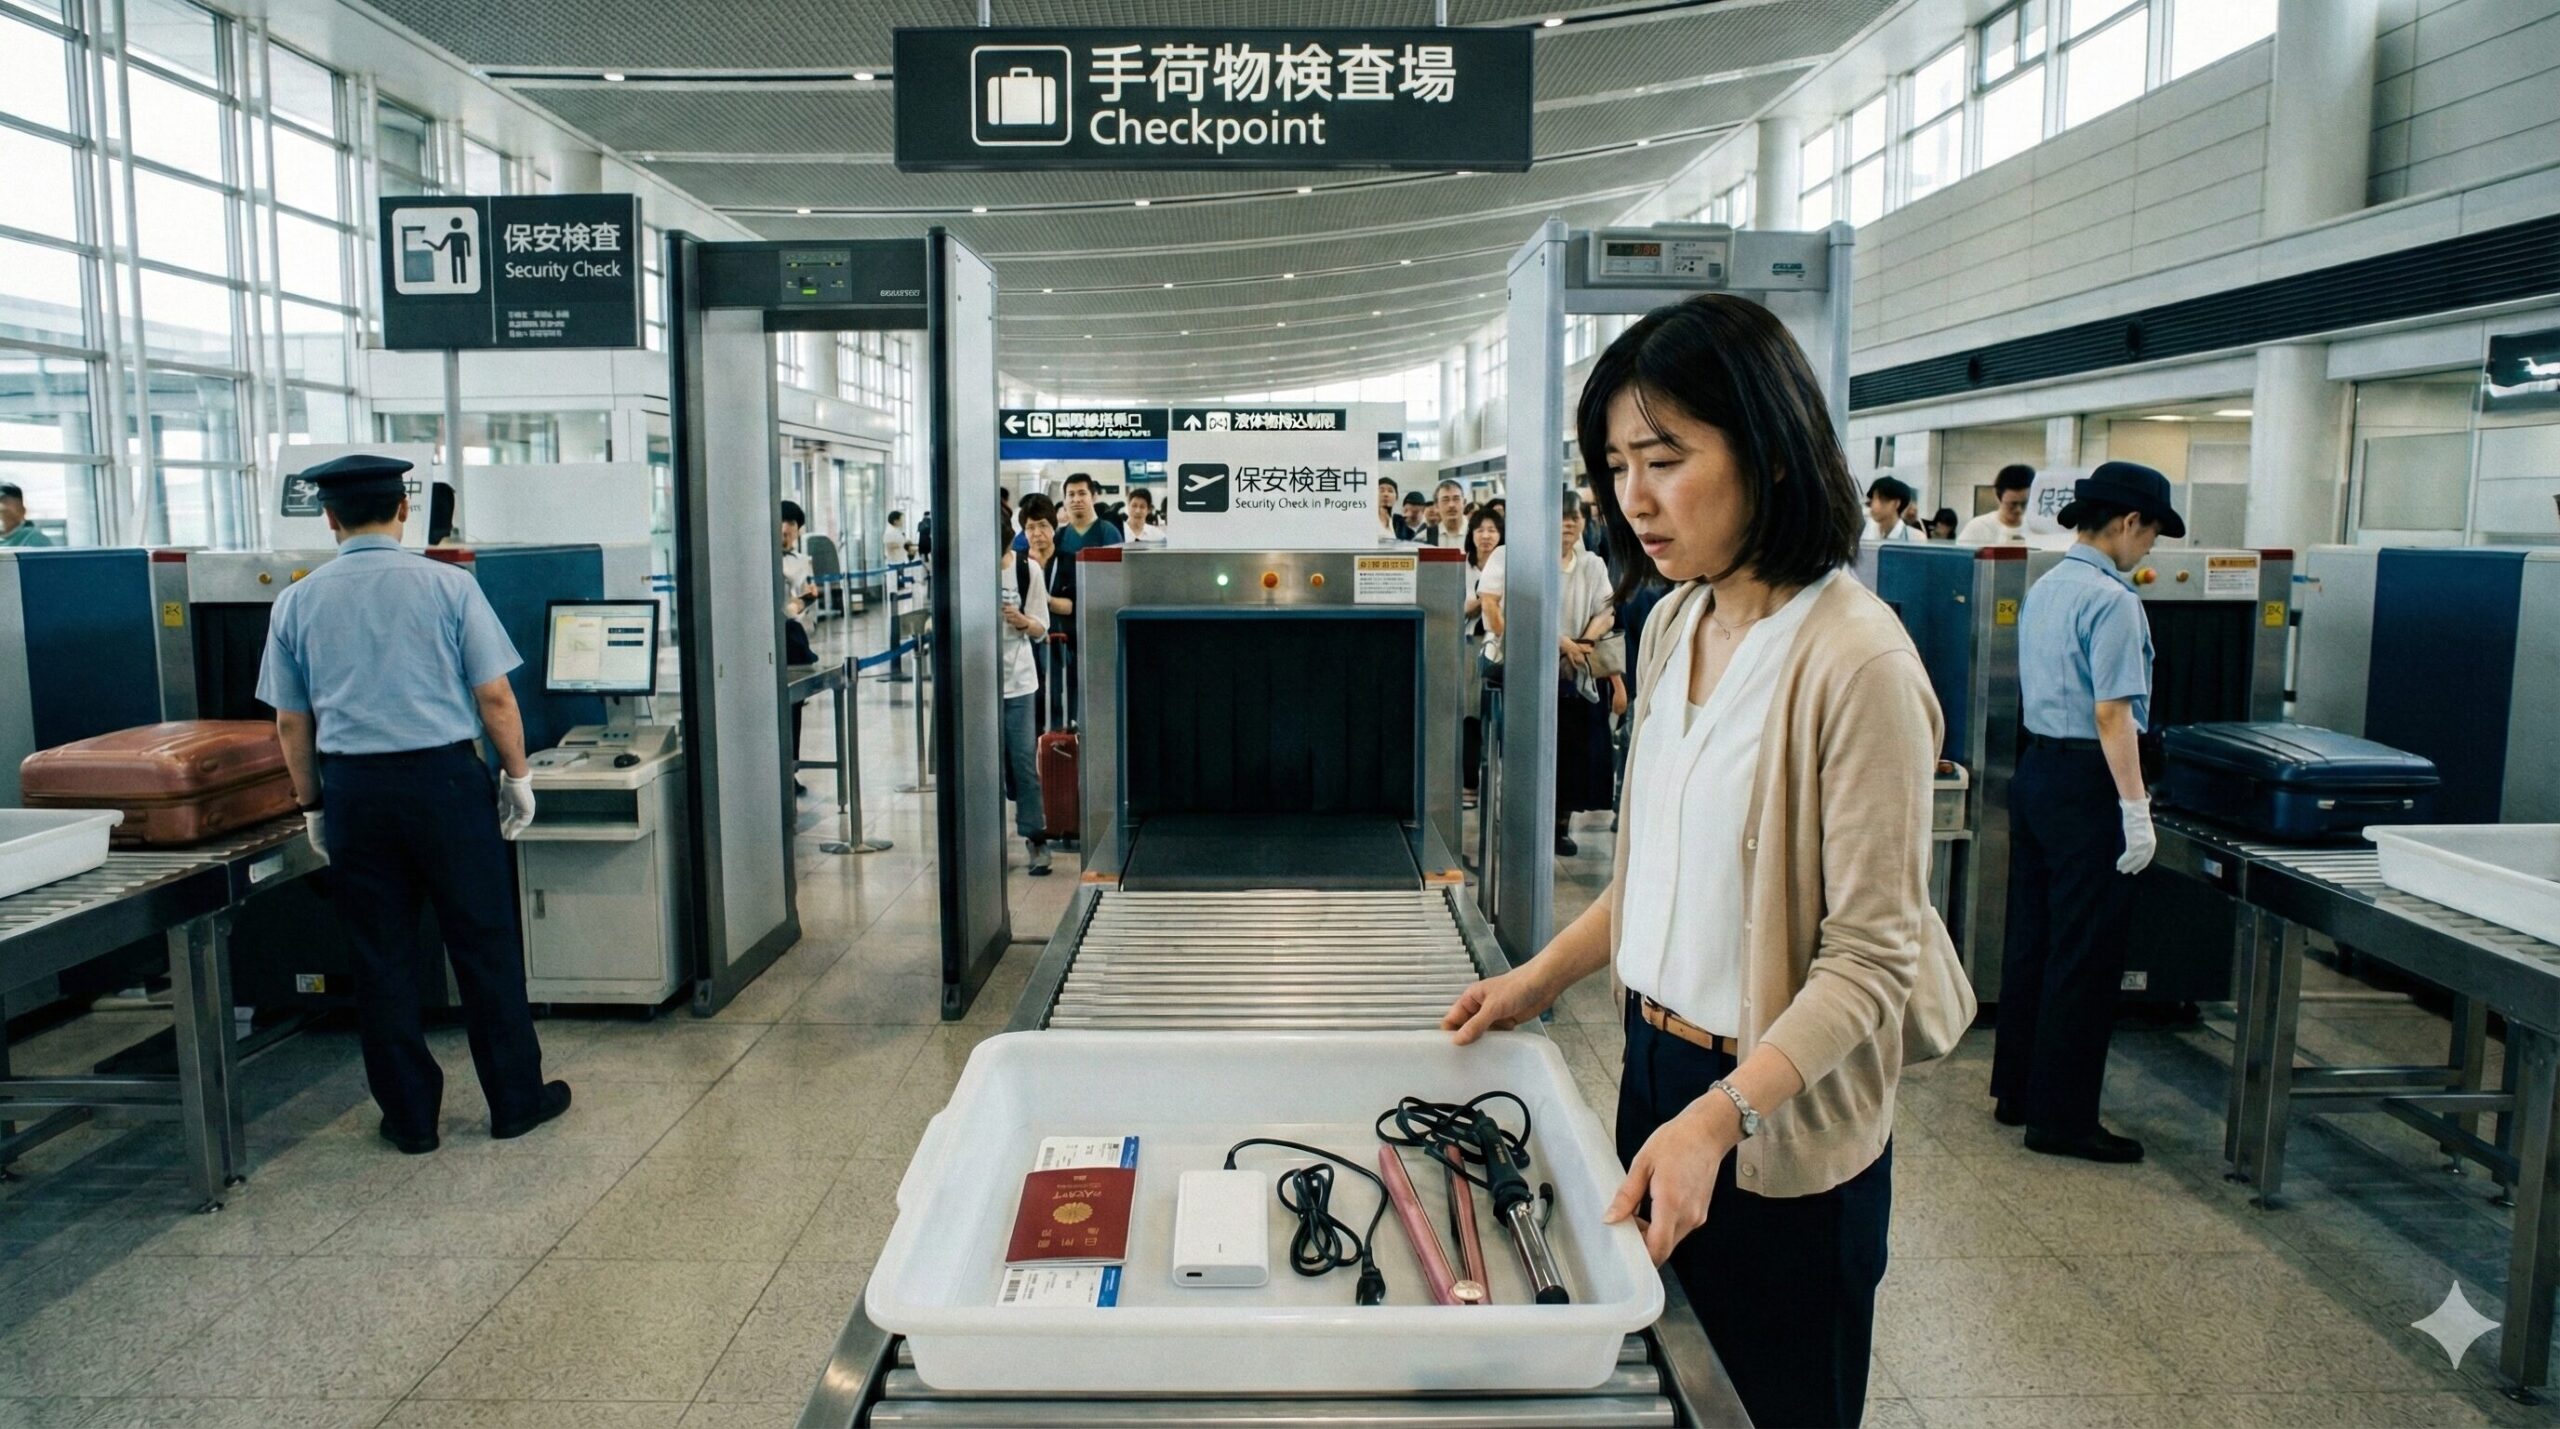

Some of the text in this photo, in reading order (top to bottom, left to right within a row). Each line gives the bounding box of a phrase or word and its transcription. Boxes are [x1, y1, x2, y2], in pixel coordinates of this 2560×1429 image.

[1088, 43, 1457, 103] 手荷物検査場
[1089, 108, 1326, 153] Checkpoint
[503, 221, 621, 253] 保安検査
[505, 259, 621, 282] Security Check
[1235, 466, 1367, 493] 保安検査中
[1235, 498, 1367, 511] Security Check in Progress
